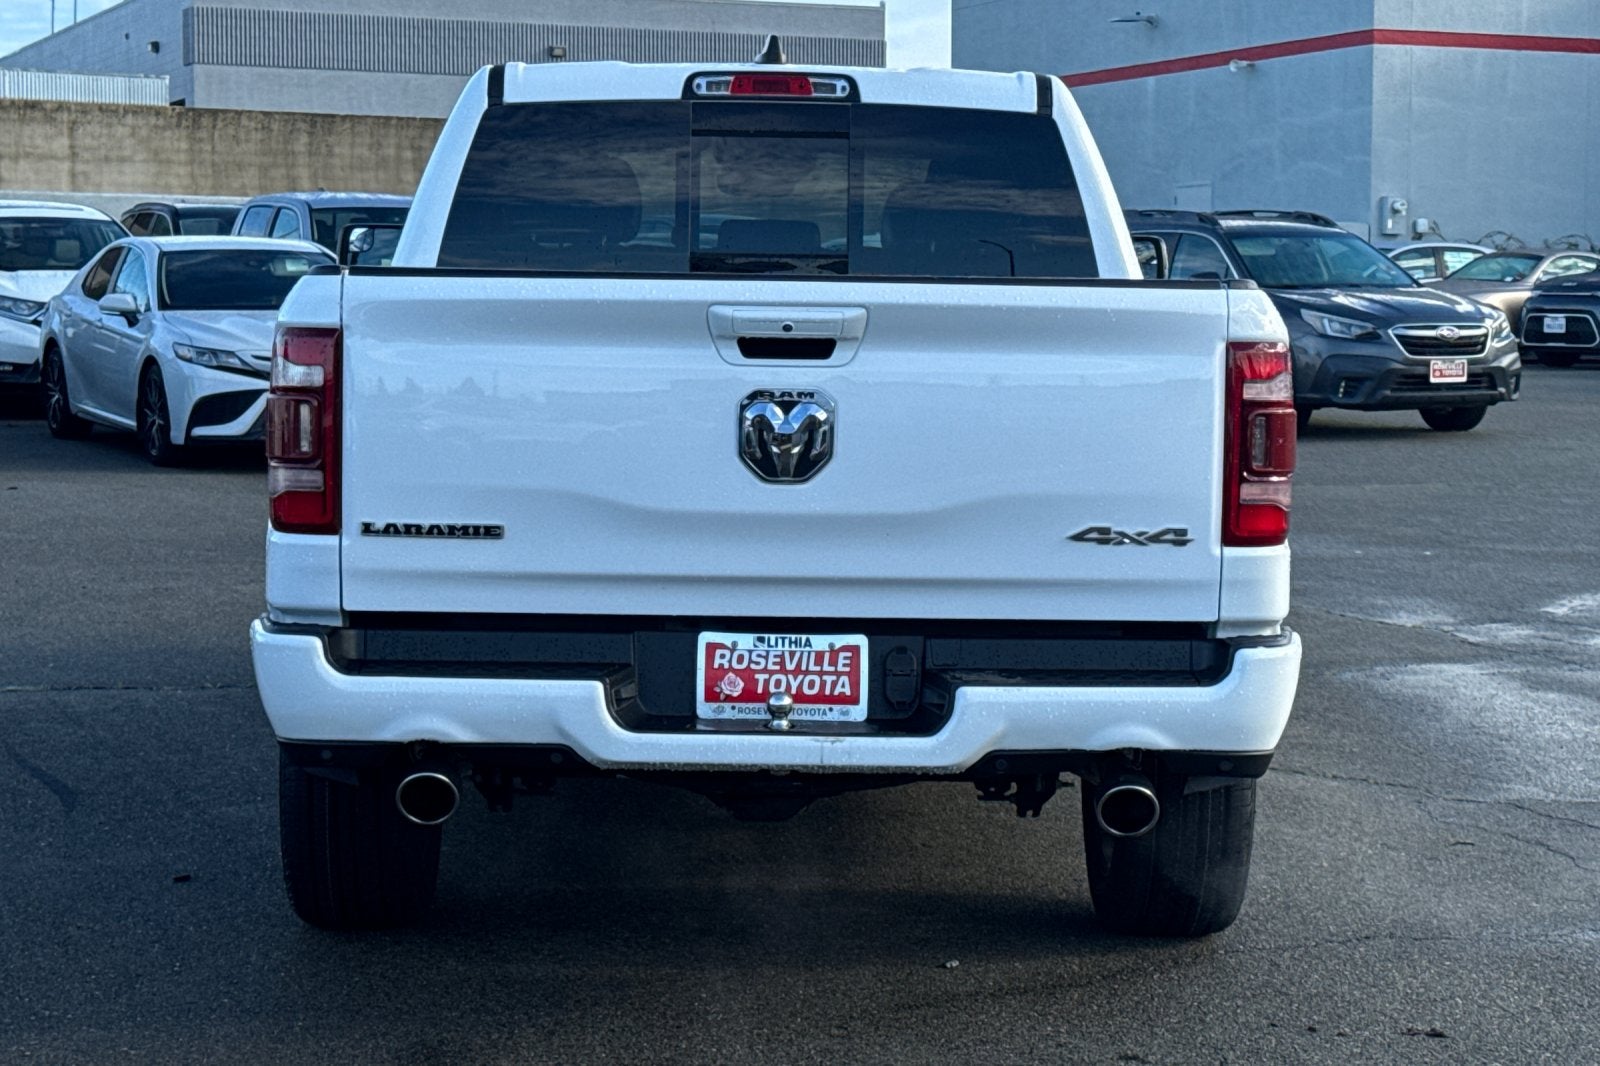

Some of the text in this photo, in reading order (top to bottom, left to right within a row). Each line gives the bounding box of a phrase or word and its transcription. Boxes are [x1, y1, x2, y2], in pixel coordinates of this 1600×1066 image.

[758, 391, 815, 399] RAM
[361, 522, 504, 538] LARAMIE
[767, 636, 813, 649] LITHIA
[713, 649, 853, 672] ROSEVILLE
[754, 673, 851, 696] TOYOTA
[737, 706, 828, 717] ROSEV TOYOTA
